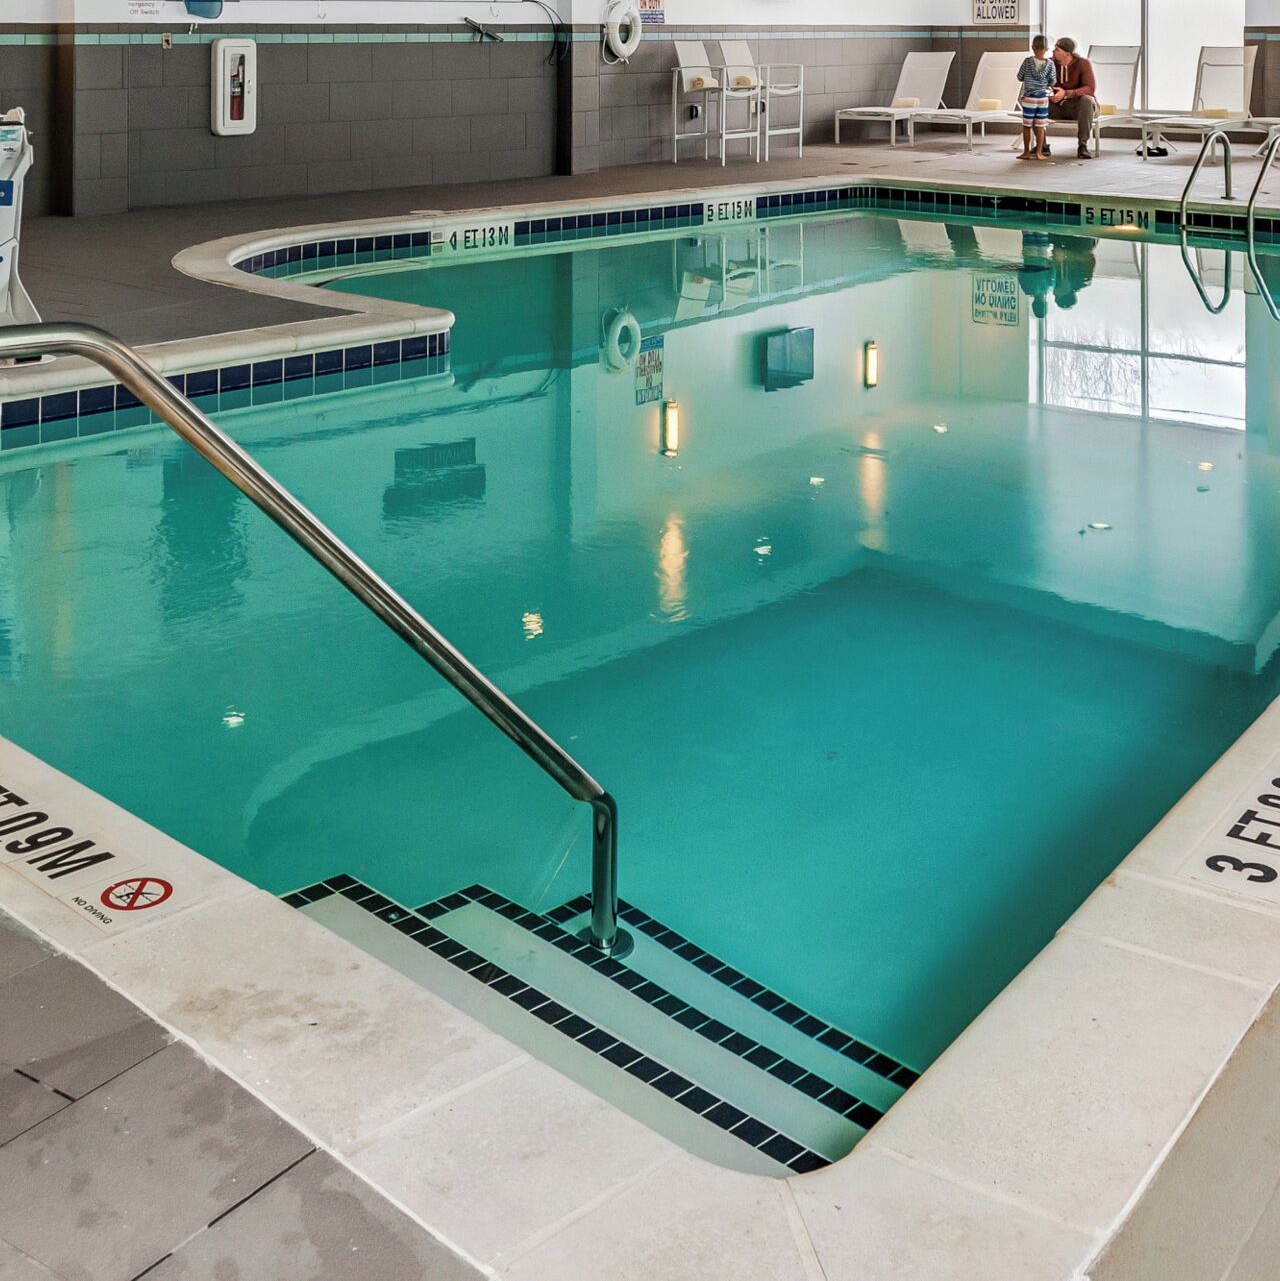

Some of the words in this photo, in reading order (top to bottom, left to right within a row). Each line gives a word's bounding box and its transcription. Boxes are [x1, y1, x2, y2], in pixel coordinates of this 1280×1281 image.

[976, 6, 1016, 19] ALLOWED
[1205, 855, 1278, 883] 3
[72, 895, 86, 908] NO
[84, 904, 113, 925] DIVING
